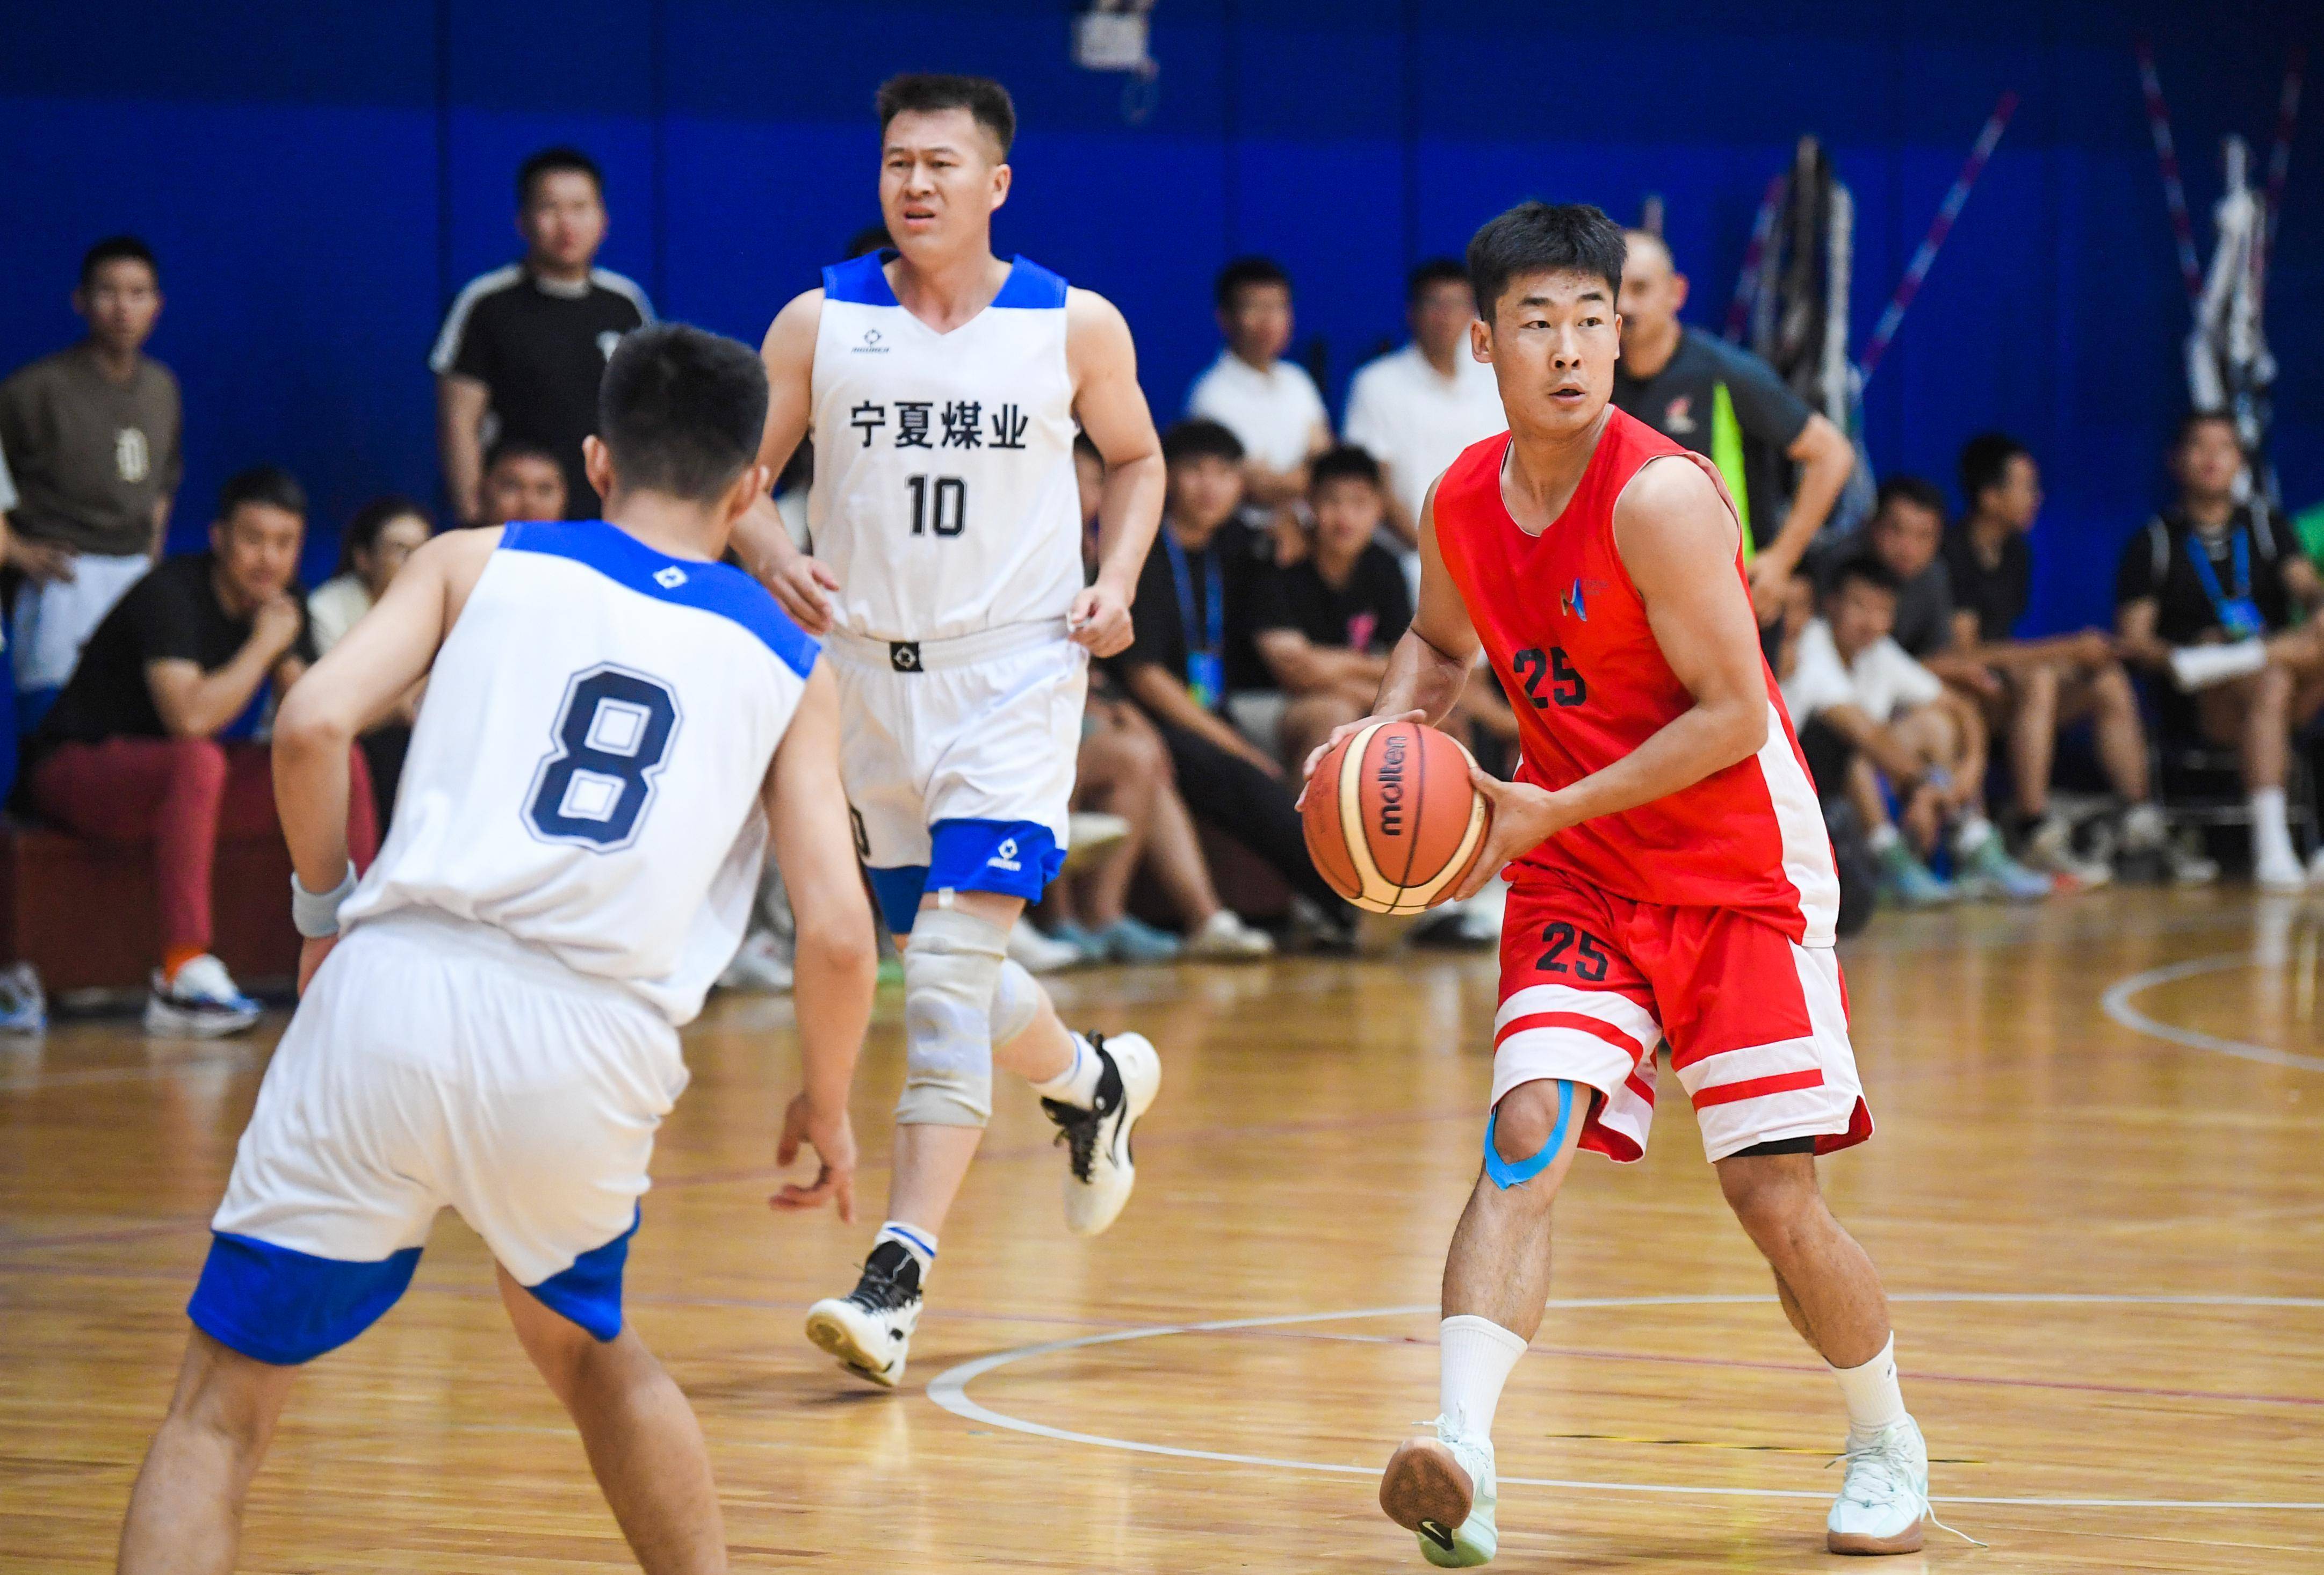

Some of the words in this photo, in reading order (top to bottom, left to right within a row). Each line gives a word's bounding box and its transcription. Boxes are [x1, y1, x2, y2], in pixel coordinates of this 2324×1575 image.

[850, 400, 1028, 450] 宁夏煤业
[905, 474, 967, 537] 10
[1513, 646, 1586, 709] 25
[519, 661, 684, 855] 8
[1377, 736, 1406, 836] molten
[1535, 921, 1608, 981] 25
